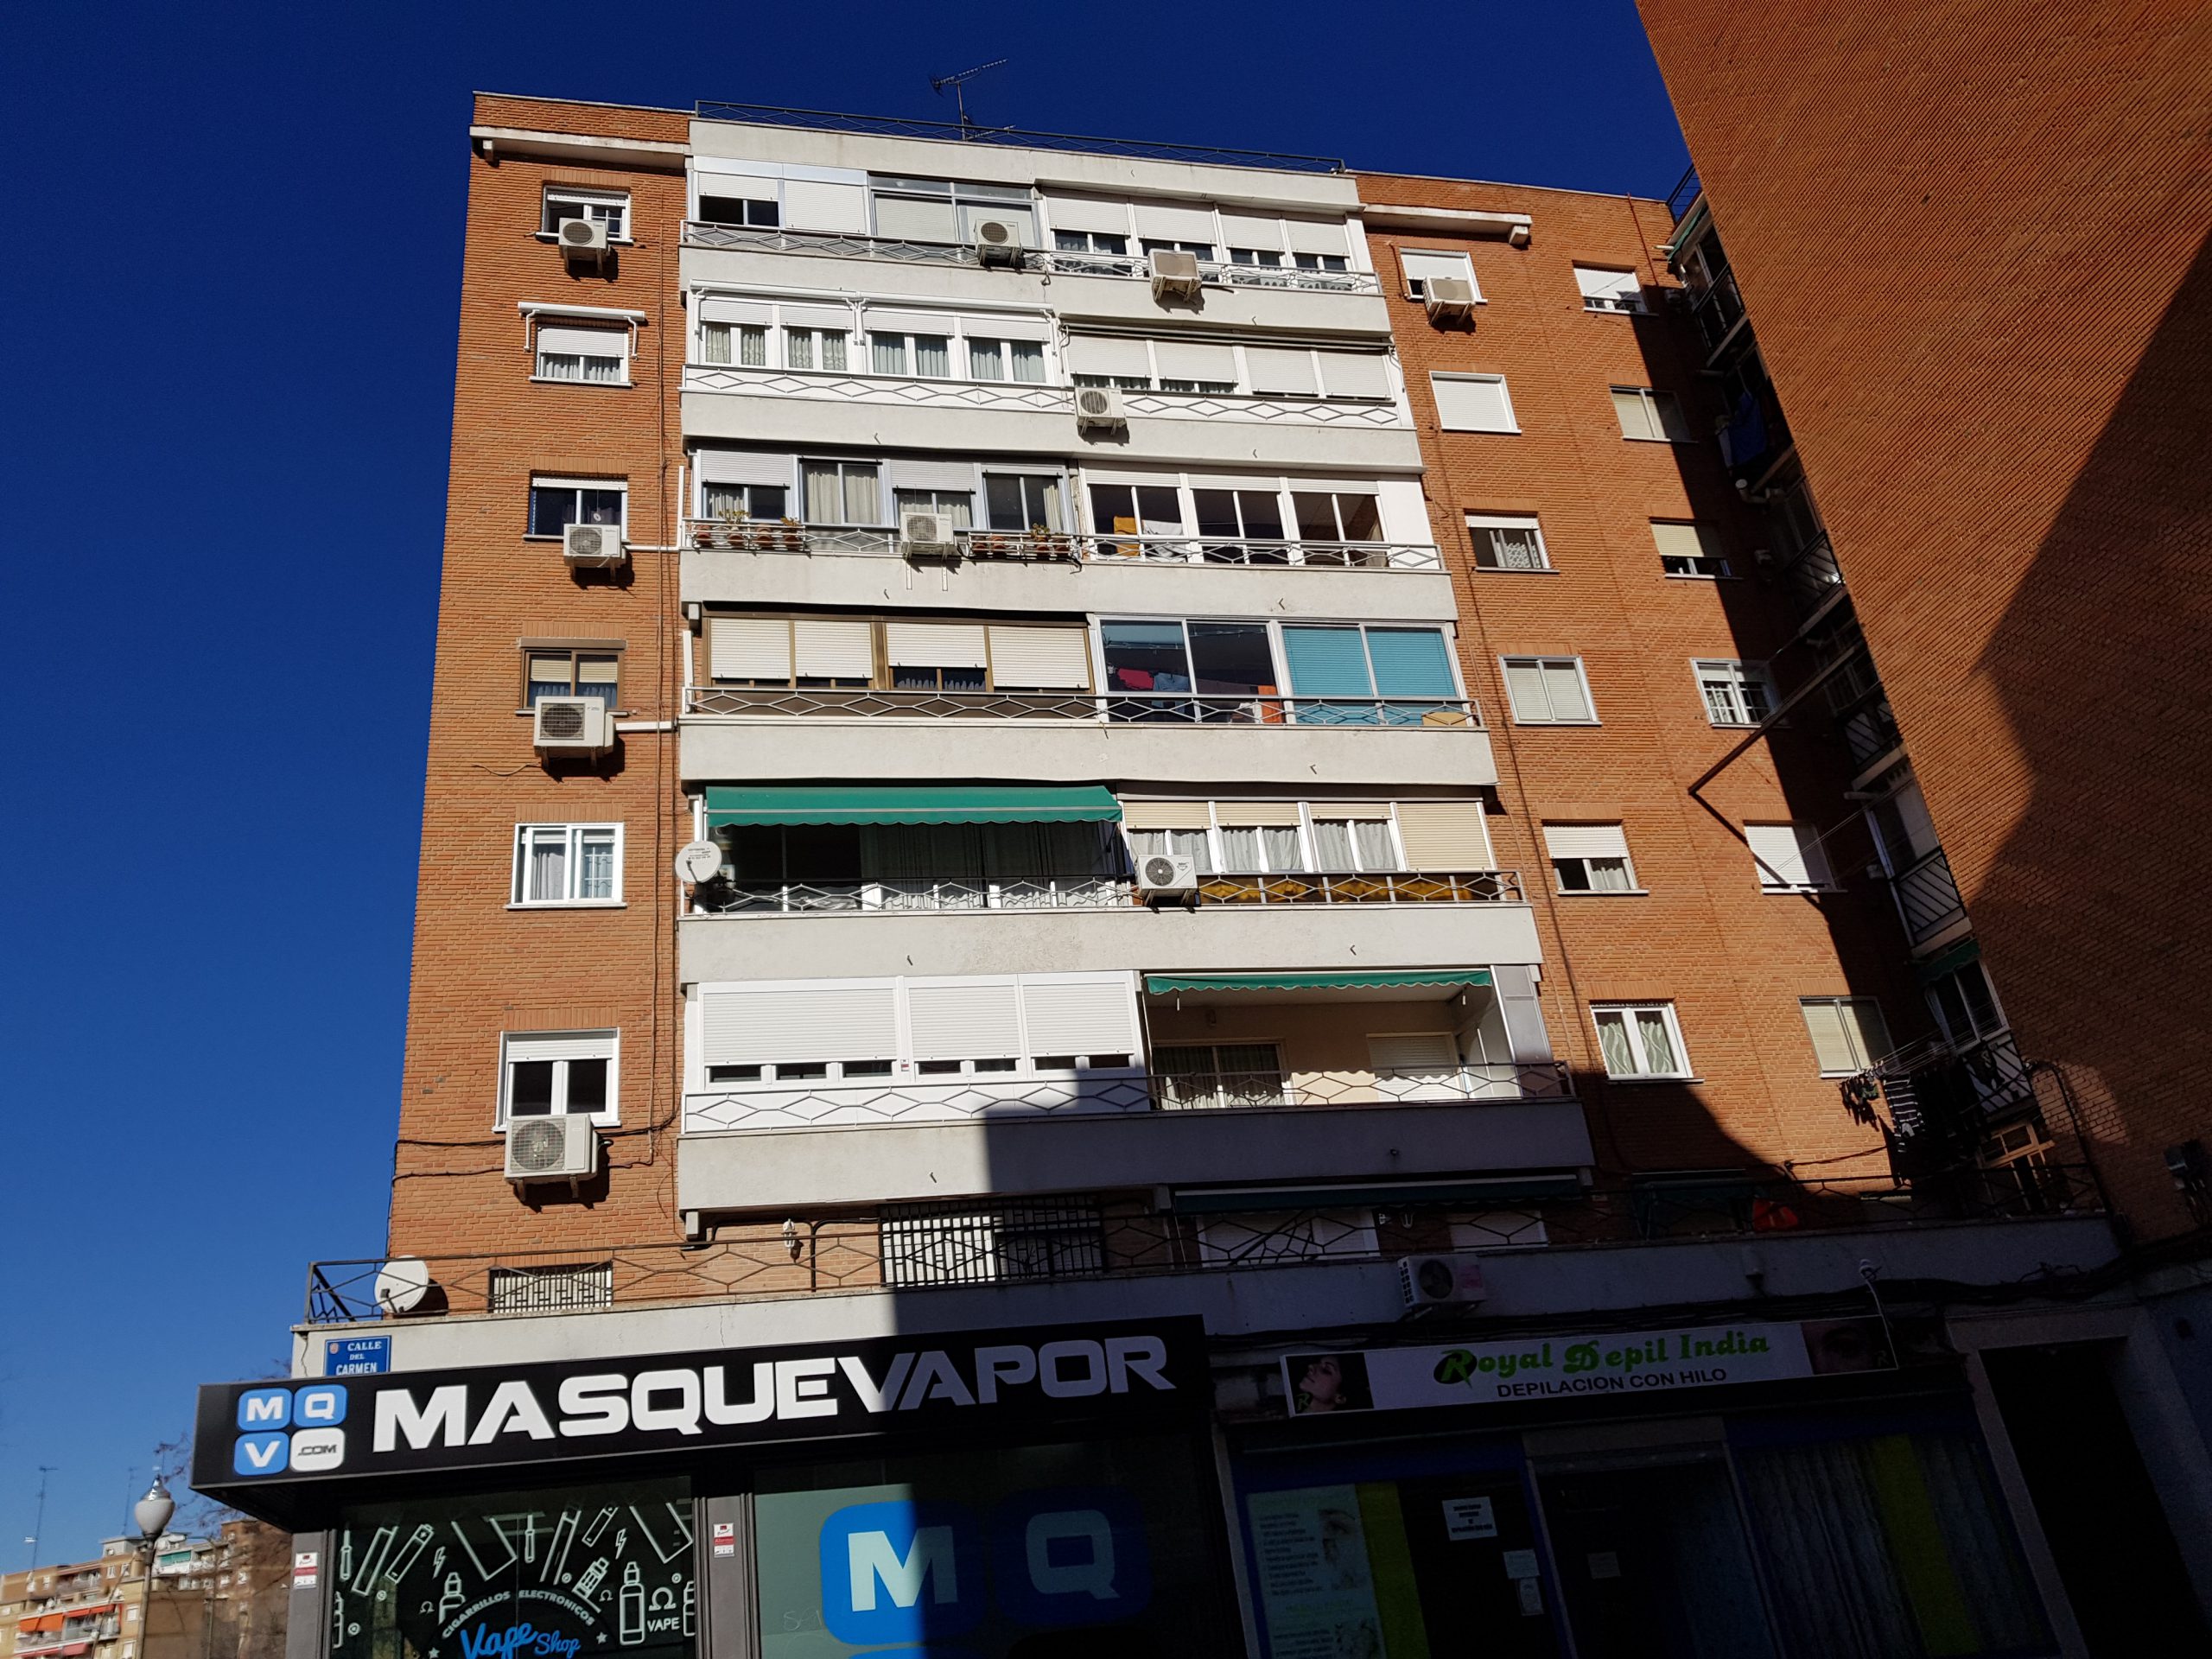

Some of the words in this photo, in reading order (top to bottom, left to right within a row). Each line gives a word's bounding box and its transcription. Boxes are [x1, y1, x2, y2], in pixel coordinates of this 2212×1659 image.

[347, 1341, 382, 1351] CALLE
[1434, 1343, 1553, 1388] Royal
[1563, 1338, 1669, 1373] Depil
[1680, 1331, 1770, 1360] India
[336, 1362, 378, 1376] CARMEN
[1497, 1376, 1624, 1398] DEPILACION
[1630, 1374, 1675, 1389] CON
[1681, 1369, 1726, 1384] HILO
[372, 1335, 1177, 1452] MASQUEVAPOR
[442, 1591, 511, 1638] CIGARRILLOS
[518, 1590, 594, 1625] ELECTRONICOS
[647, 1618, 681, 1631] VAPE
[461, 1623, 538, 1659] Vape
[535, 1630, 581, 1659] Shop
